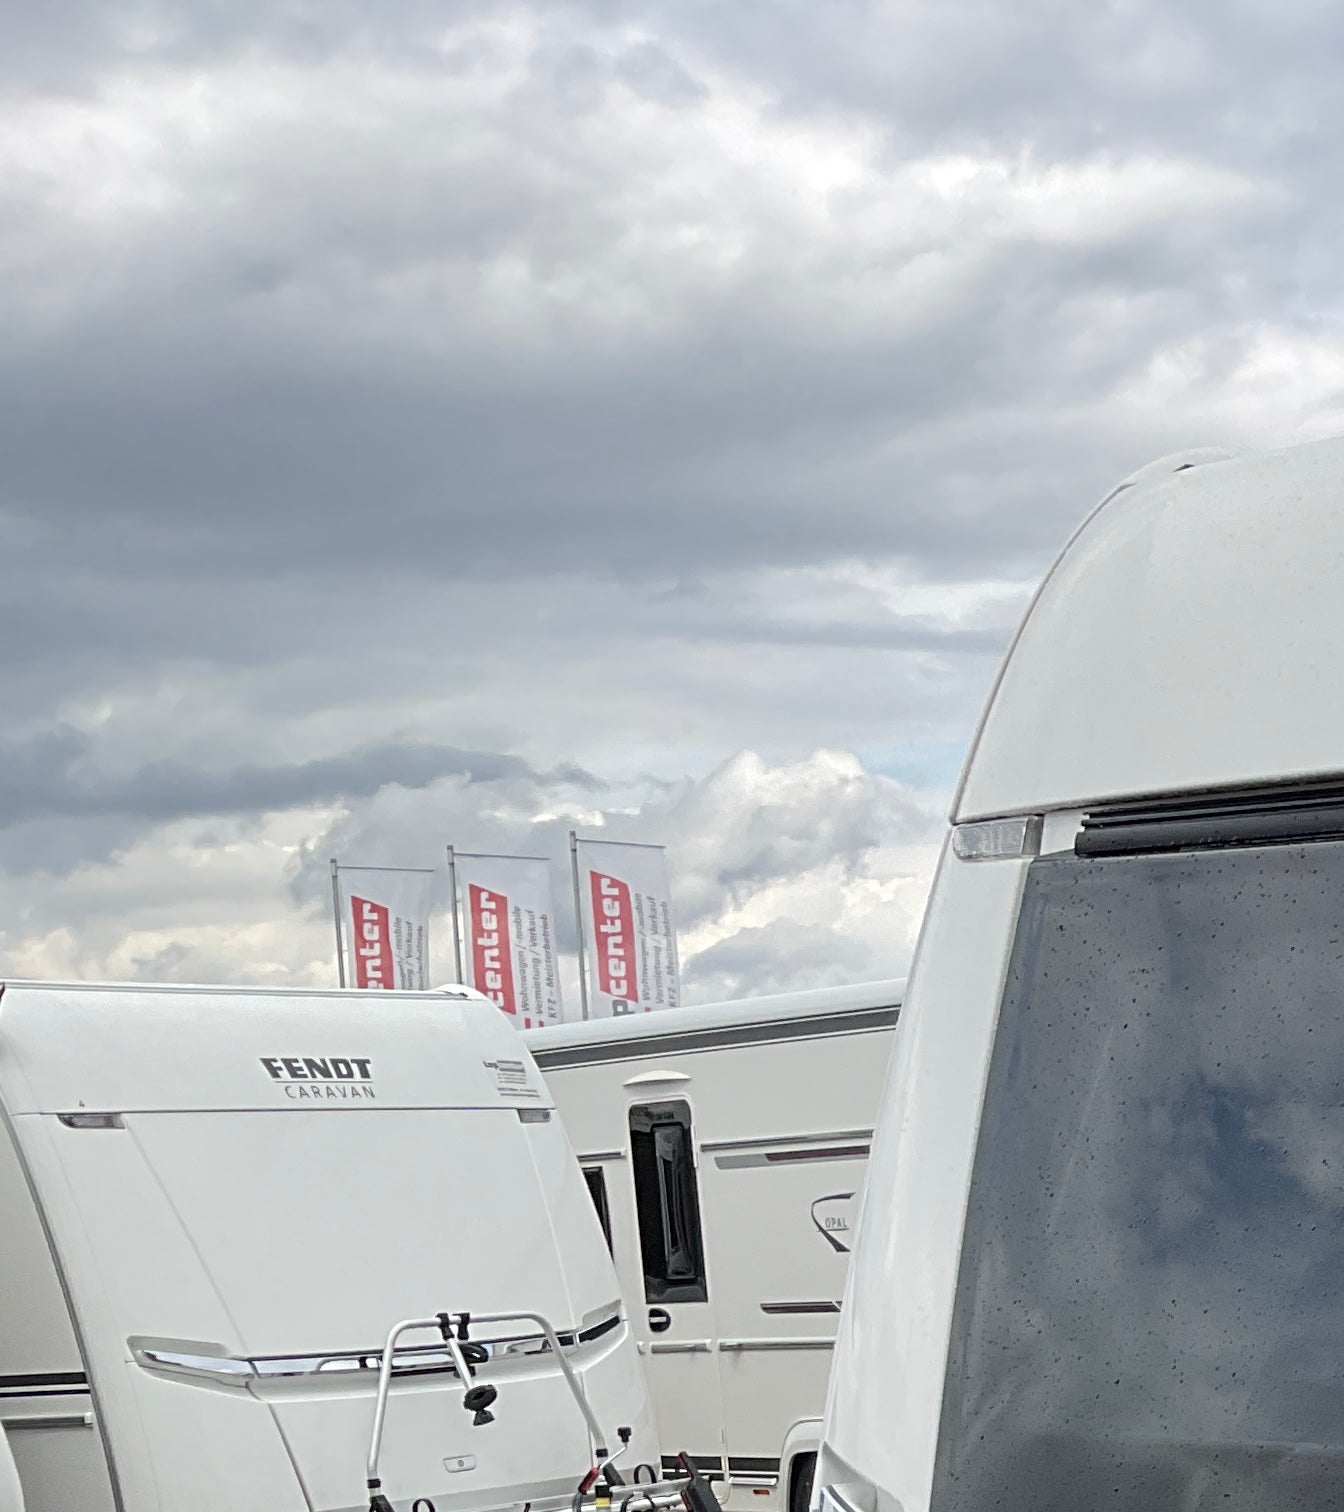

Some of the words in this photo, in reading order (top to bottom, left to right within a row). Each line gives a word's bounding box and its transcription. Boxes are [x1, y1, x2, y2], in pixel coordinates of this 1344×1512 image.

[525, 908, 537, 948] Verkauf
[518, 951, 530, 1012] Wohnwagen
[531, 957, 543, 1015] Vermietung
[259, 1058, 372, 1079] FENDT
[284, 1085, 376, 1100] CARAVAN
[825, 1217, 847, 1228] OPAL
